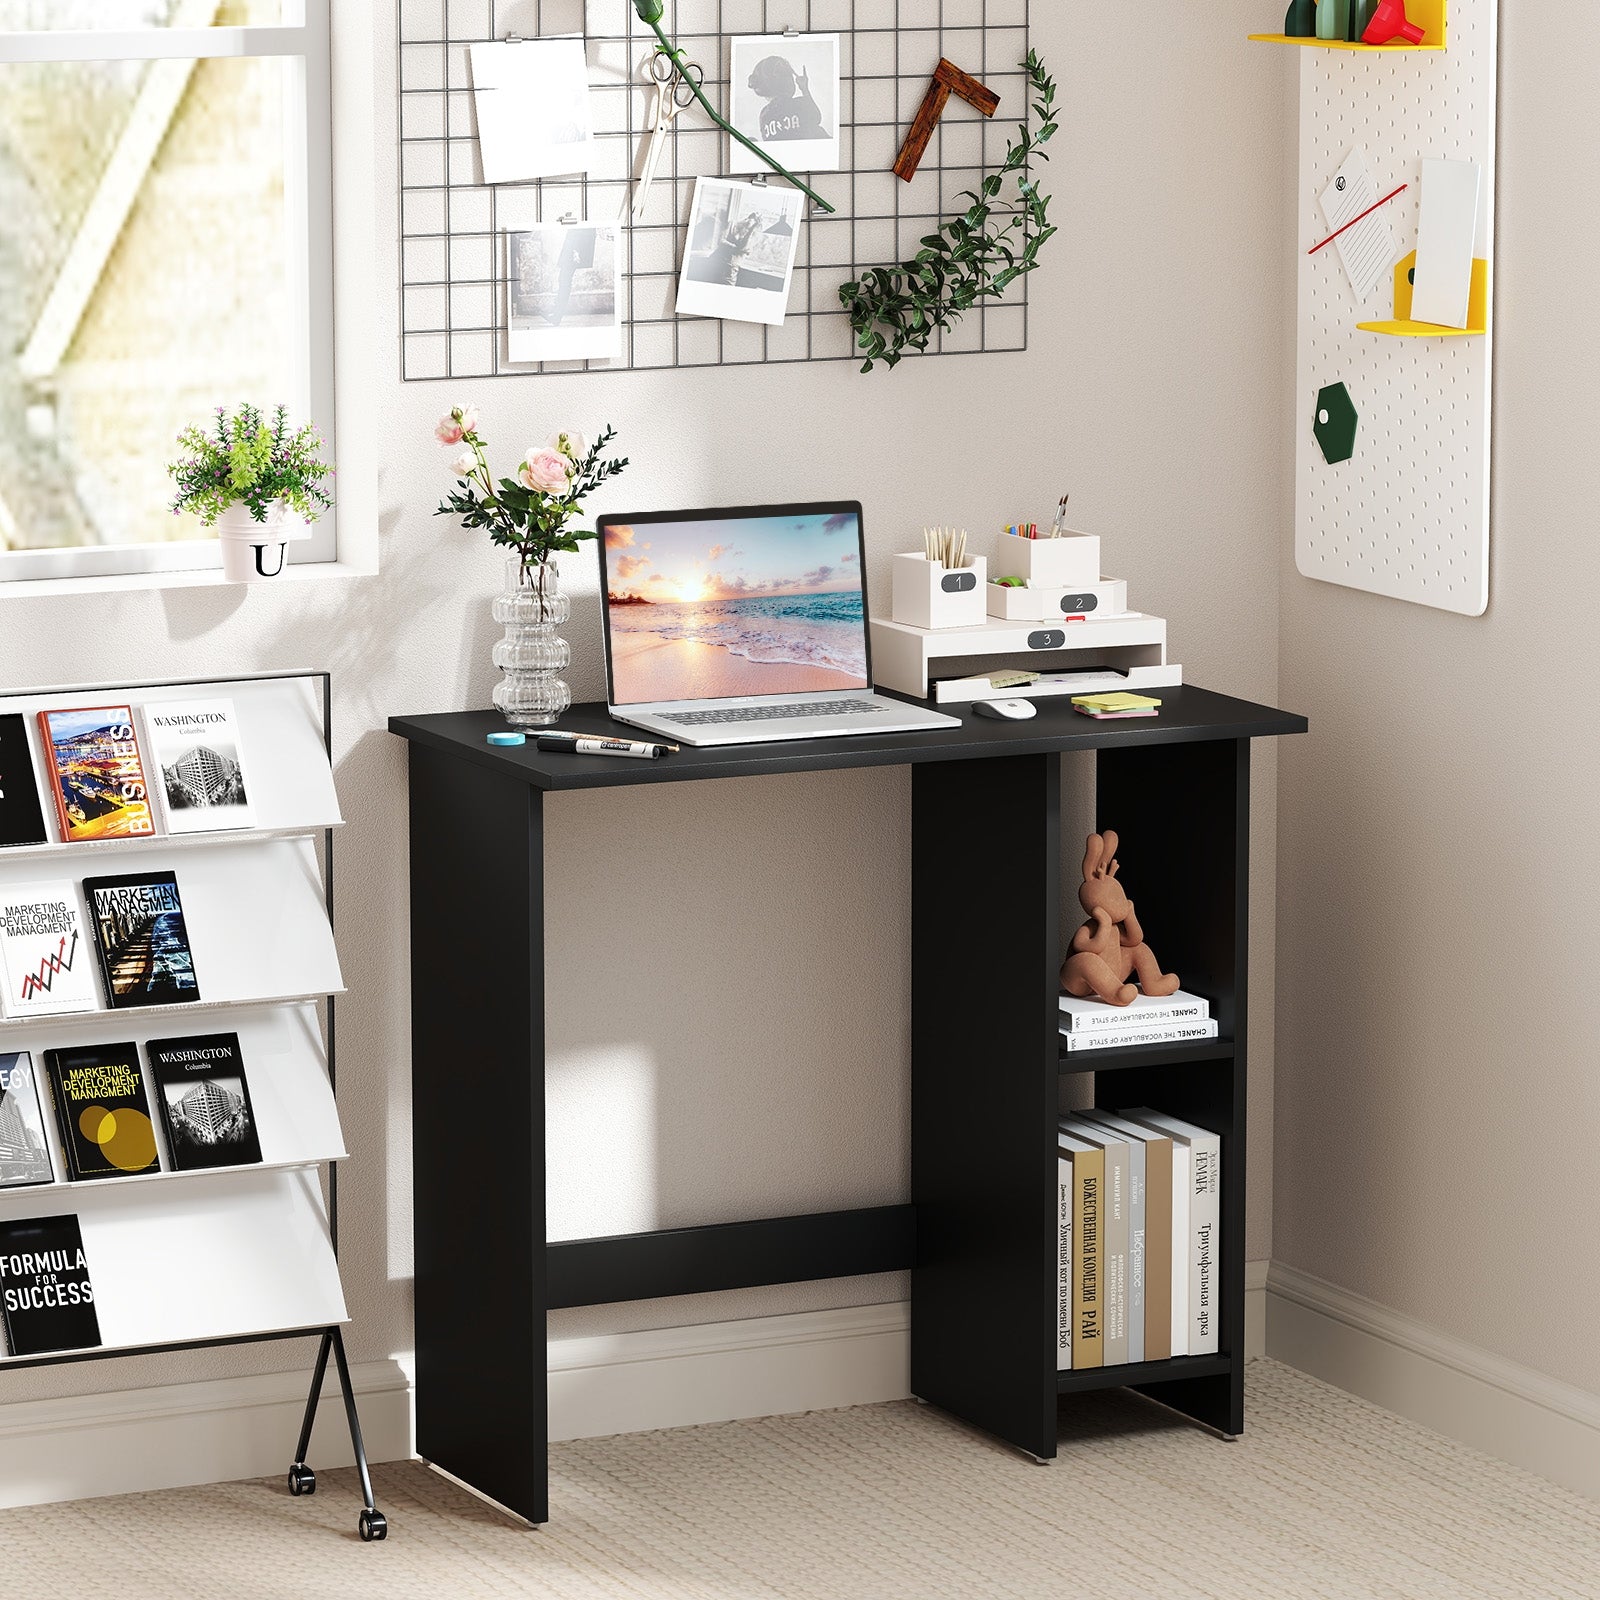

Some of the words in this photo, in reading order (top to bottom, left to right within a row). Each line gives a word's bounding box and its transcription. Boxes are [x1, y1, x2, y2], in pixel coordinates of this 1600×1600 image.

[249, 542, 287, 577] U
[955, 576, 962, 590] 1
[1075, 598, 1083, 609] 2
[1044, 634, 1052, 646] 3
[154, 713, 226, 726] WASHINGTON
[179, 727, 206, 735] Columbia
[107, 710, 152, 833] BUSINESS
[95, 885, 177, 907] MARKETIN
[5, 902, 66, 916] MARKETING
[0, 911, 75, 927] DEVELOPMENT
[6, 922, 72, 937] MANAGMENT
[1119, 1013, 1158, 1022] VOCABULARY
[1171, 1008, 1198, 1016] CHANEL
[1092, 1016, 1109, 1025] STYLE
[1120, 1034, 1163, 1044] VOCABULARY
[1177, 1028, 1207, 1037] CHANEL
[1089, 1038, 1108, 1046] STYLE
[160, 1047, 232, 1063] WASHINGTON
[69, 1064, 130, 1080] MARKETING
[185, 1062, 211, 1070] Columbia
[64, 1074, 139, 1091] DEVELOPMENT
[71, 1084, 136, 1101] MANAGMENT
[1083, 1177, 1097, 1254] БОЖЕСТВЕННАЯ
[1059, 1222, 1071, 1266] Уличный
[0, 1248, 87, 1277] FORMULA
[1131, 1229, 1145, 1288] Избранное
[1197, 1222, 1212, 1306] Триумфальная
[35, 1274, 57, 1285] FOR
[1060, 1267, 1068, 1283] кот
[1081, 1256, 1097, 1302] КОМЕДИЯ
[5, 1281, 94, 1311] SUCCESS
[1058, 1286, 1068, 1297] по
[1059, 1298, 1068, 1328] имени
[1082, 1309, 1100, 1339] РАЙ
[1197, 1311, 1209, 1336] арка
[1059, 1330, 1071, 1348] Боб
